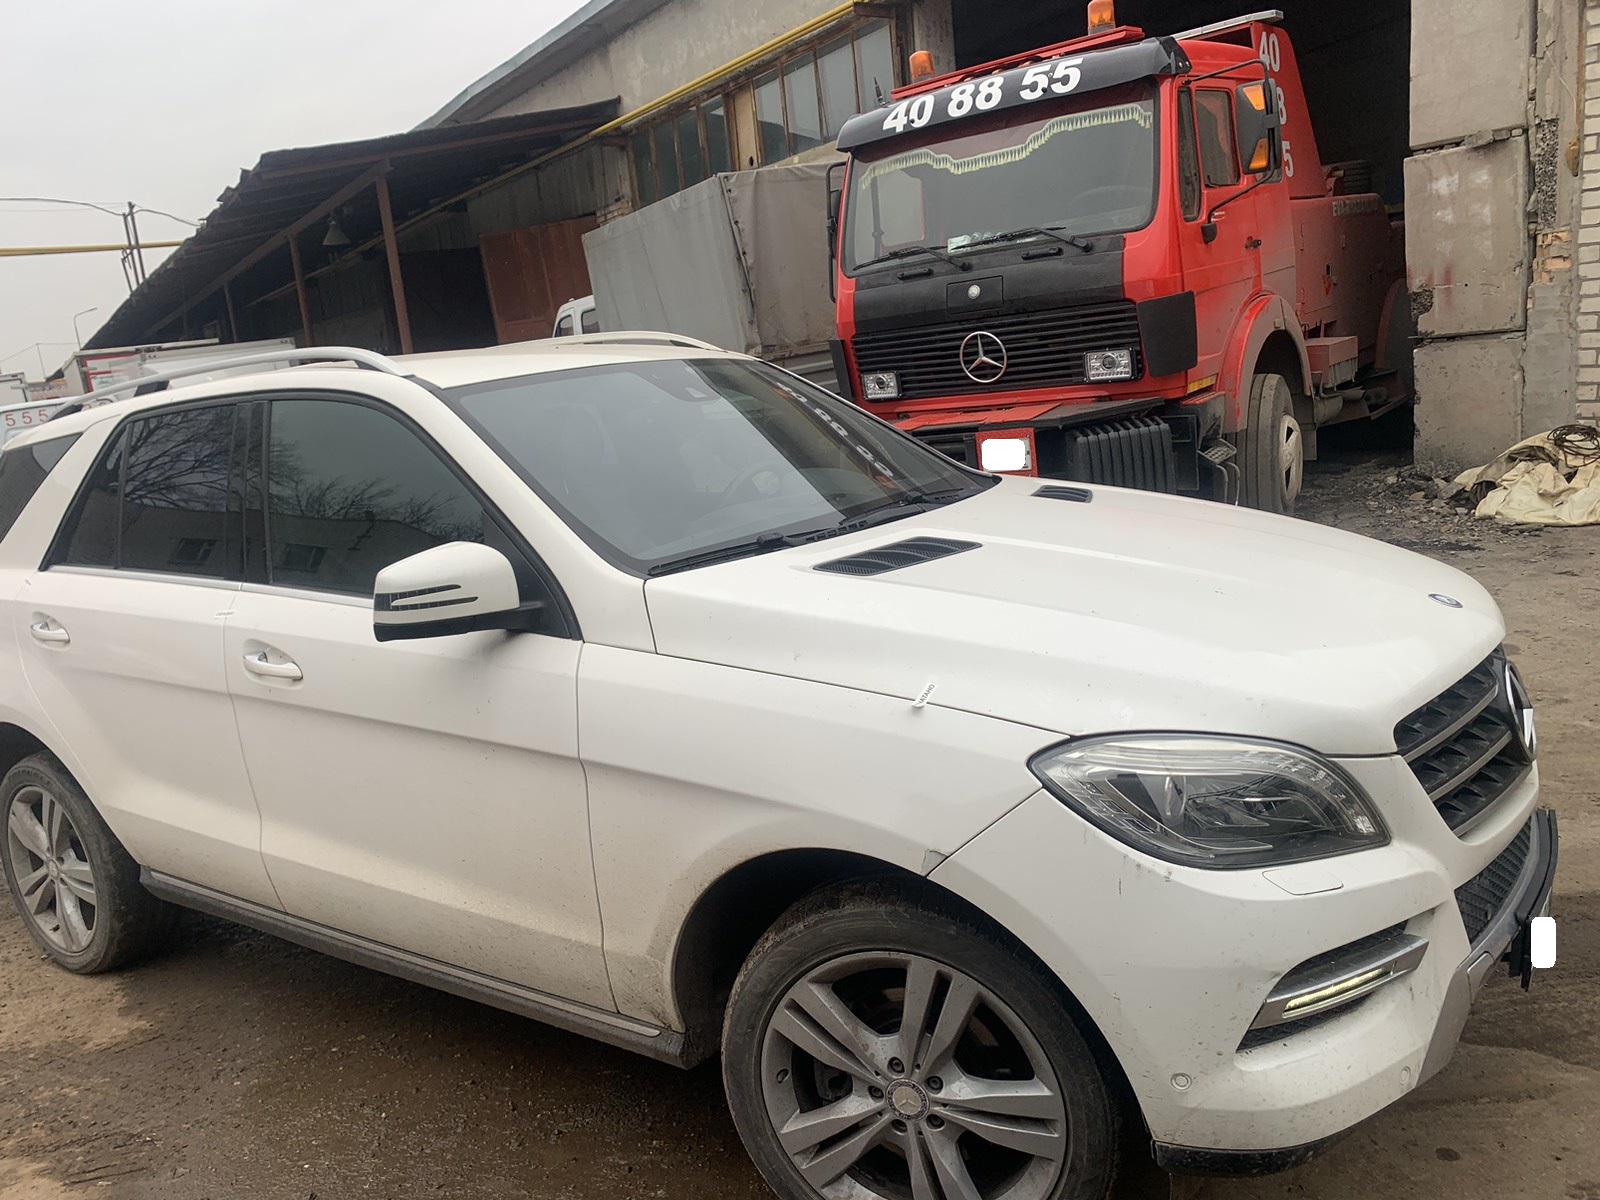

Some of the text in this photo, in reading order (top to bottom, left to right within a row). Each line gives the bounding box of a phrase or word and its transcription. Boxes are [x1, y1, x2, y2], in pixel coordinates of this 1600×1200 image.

[1259, 31, 1280, 72] 40
[882, 57, 1084, 133] 40 88 55
[1276, 86, 1287, 125] 8
[1281, 140, 1294, 178] 5
